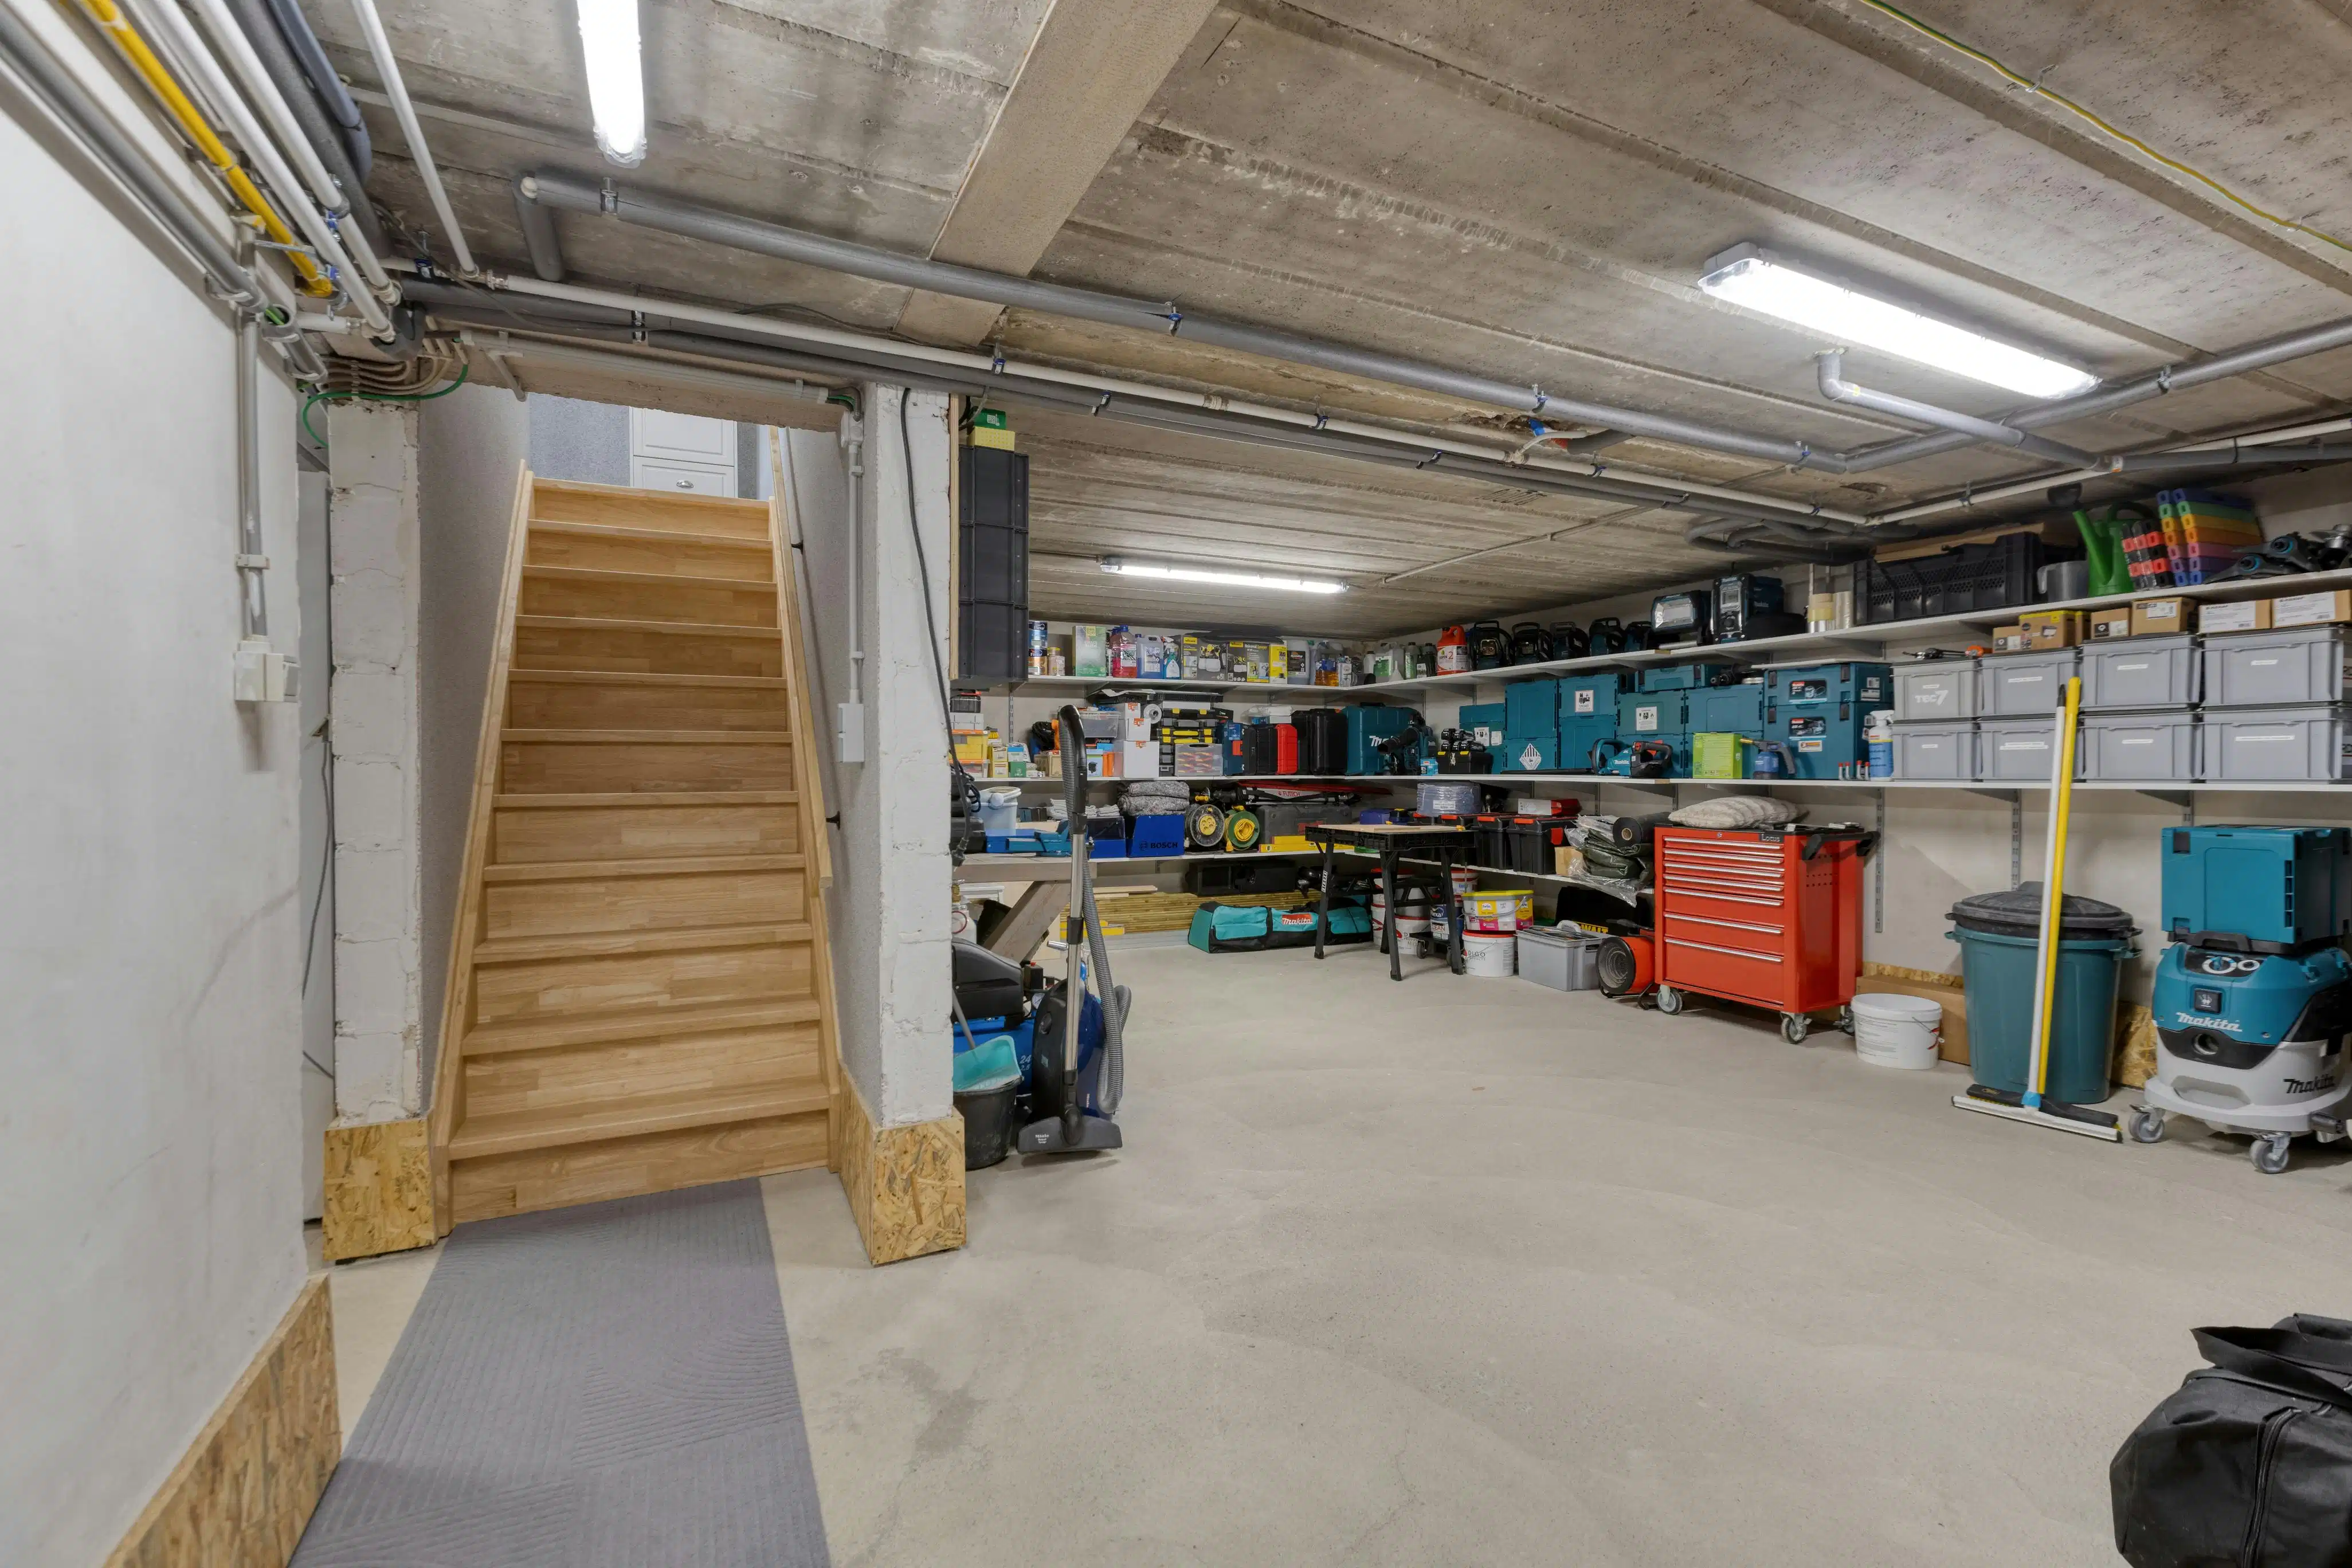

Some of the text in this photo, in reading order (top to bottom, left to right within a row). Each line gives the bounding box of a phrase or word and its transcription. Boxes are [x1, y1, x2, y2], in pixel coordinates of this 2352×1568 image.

[1448, 651, 1453, 659] 2
[1915, 690, 1949, 705] TEC7
[1150, 841, 1178, 849] BOSCH
